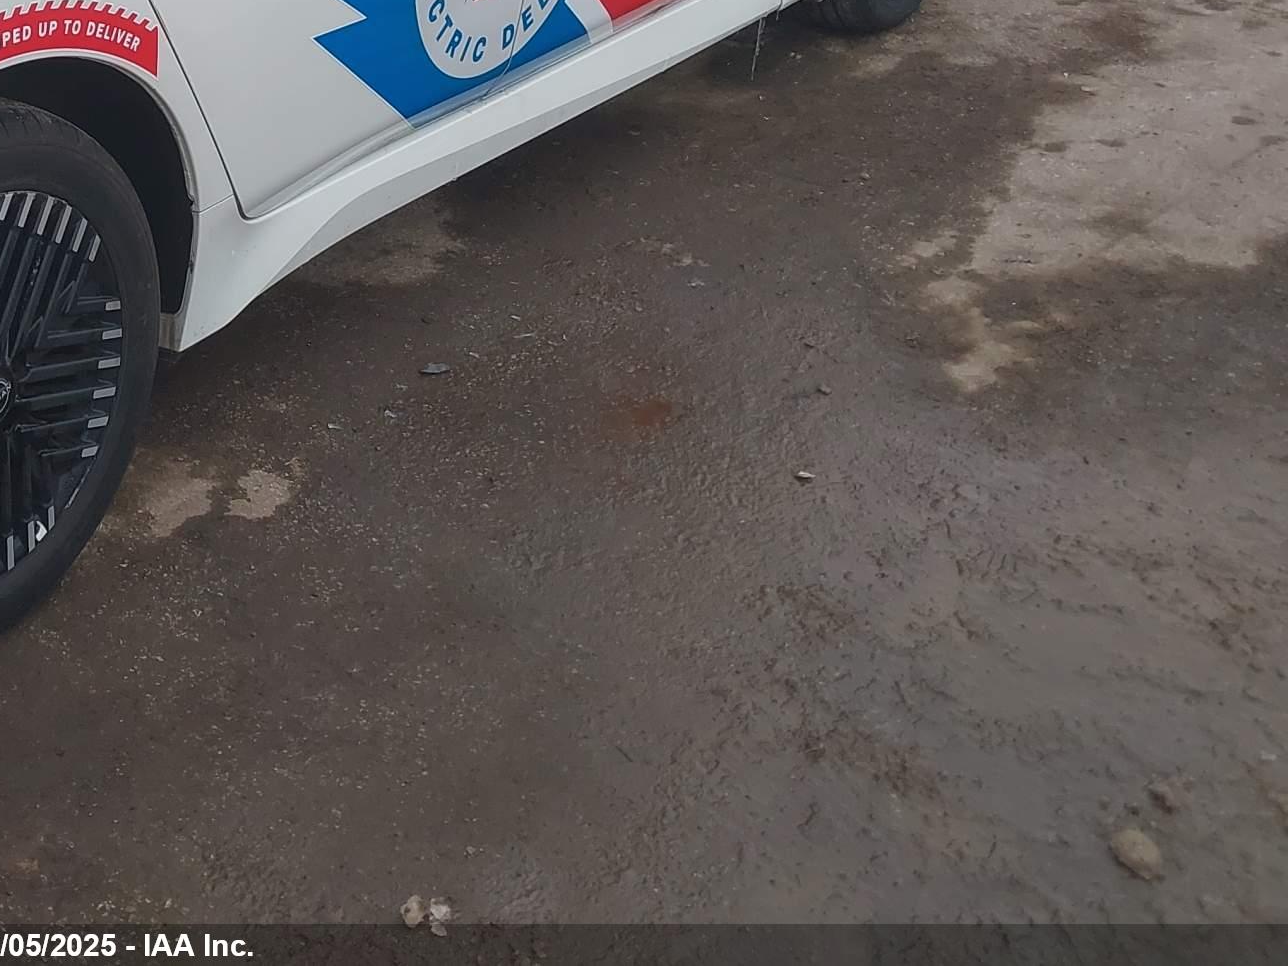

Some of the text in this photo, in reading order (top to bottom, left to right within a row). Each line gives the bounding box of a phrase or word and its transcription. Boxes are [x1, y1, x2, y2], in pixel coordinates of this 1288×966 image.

[38, 20, 58, 37] UP
[63, 19, 81, 34] TO
[87, 21, 141, 52] DELIVER
